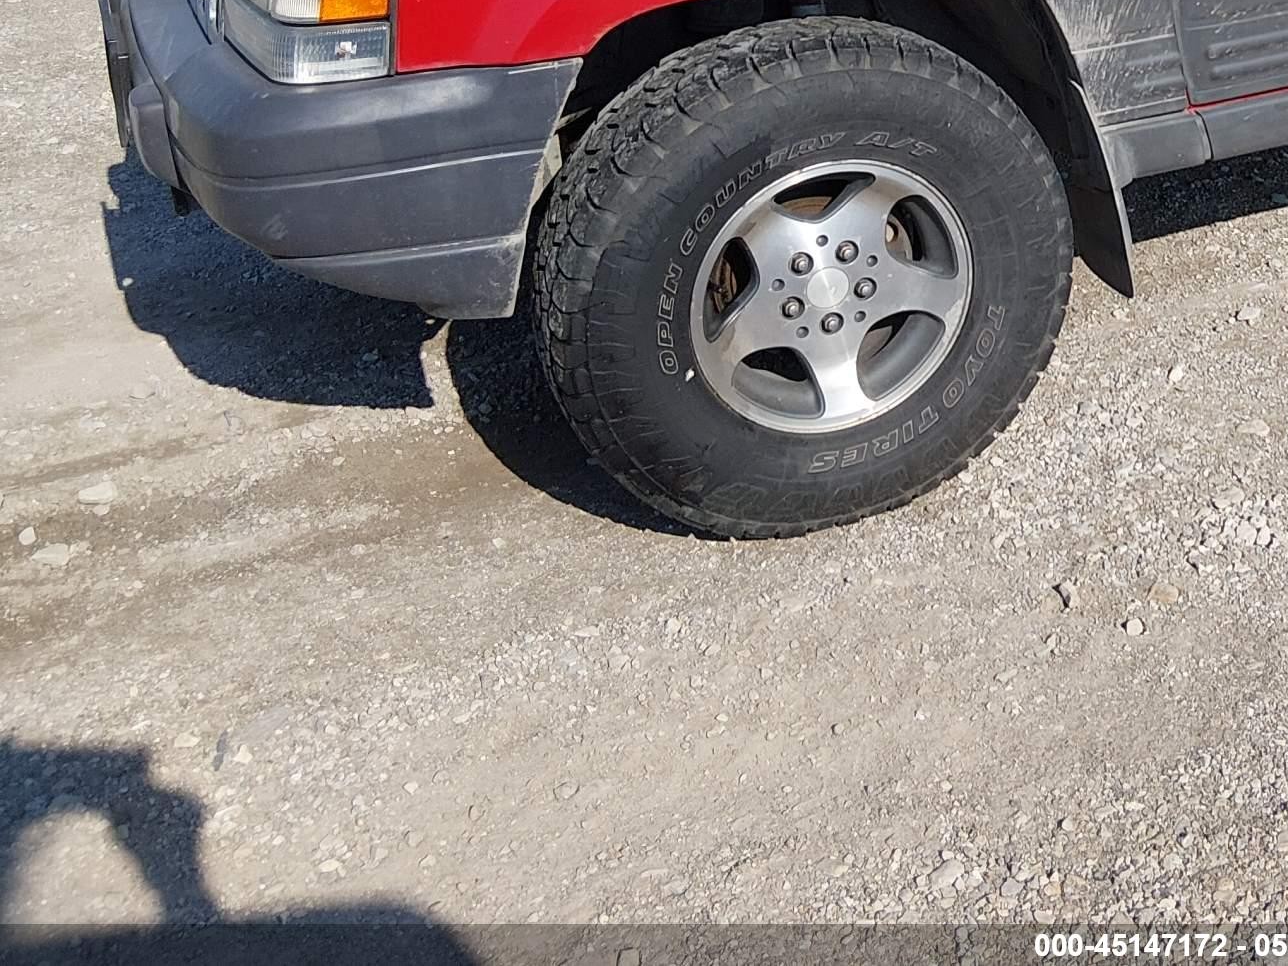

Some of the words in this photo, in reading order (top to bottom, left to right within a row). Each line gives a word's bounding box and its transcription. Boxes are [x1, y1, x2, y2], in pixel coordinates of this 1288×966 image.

[657, 262, 684, 375] OPEN
[680, 132, 846, 256] COUNTRY
[856, 131, 938, 158] A/T
[942, 305, 1006, 409] TOYO
[807, 405, 940, 474] TIRES
